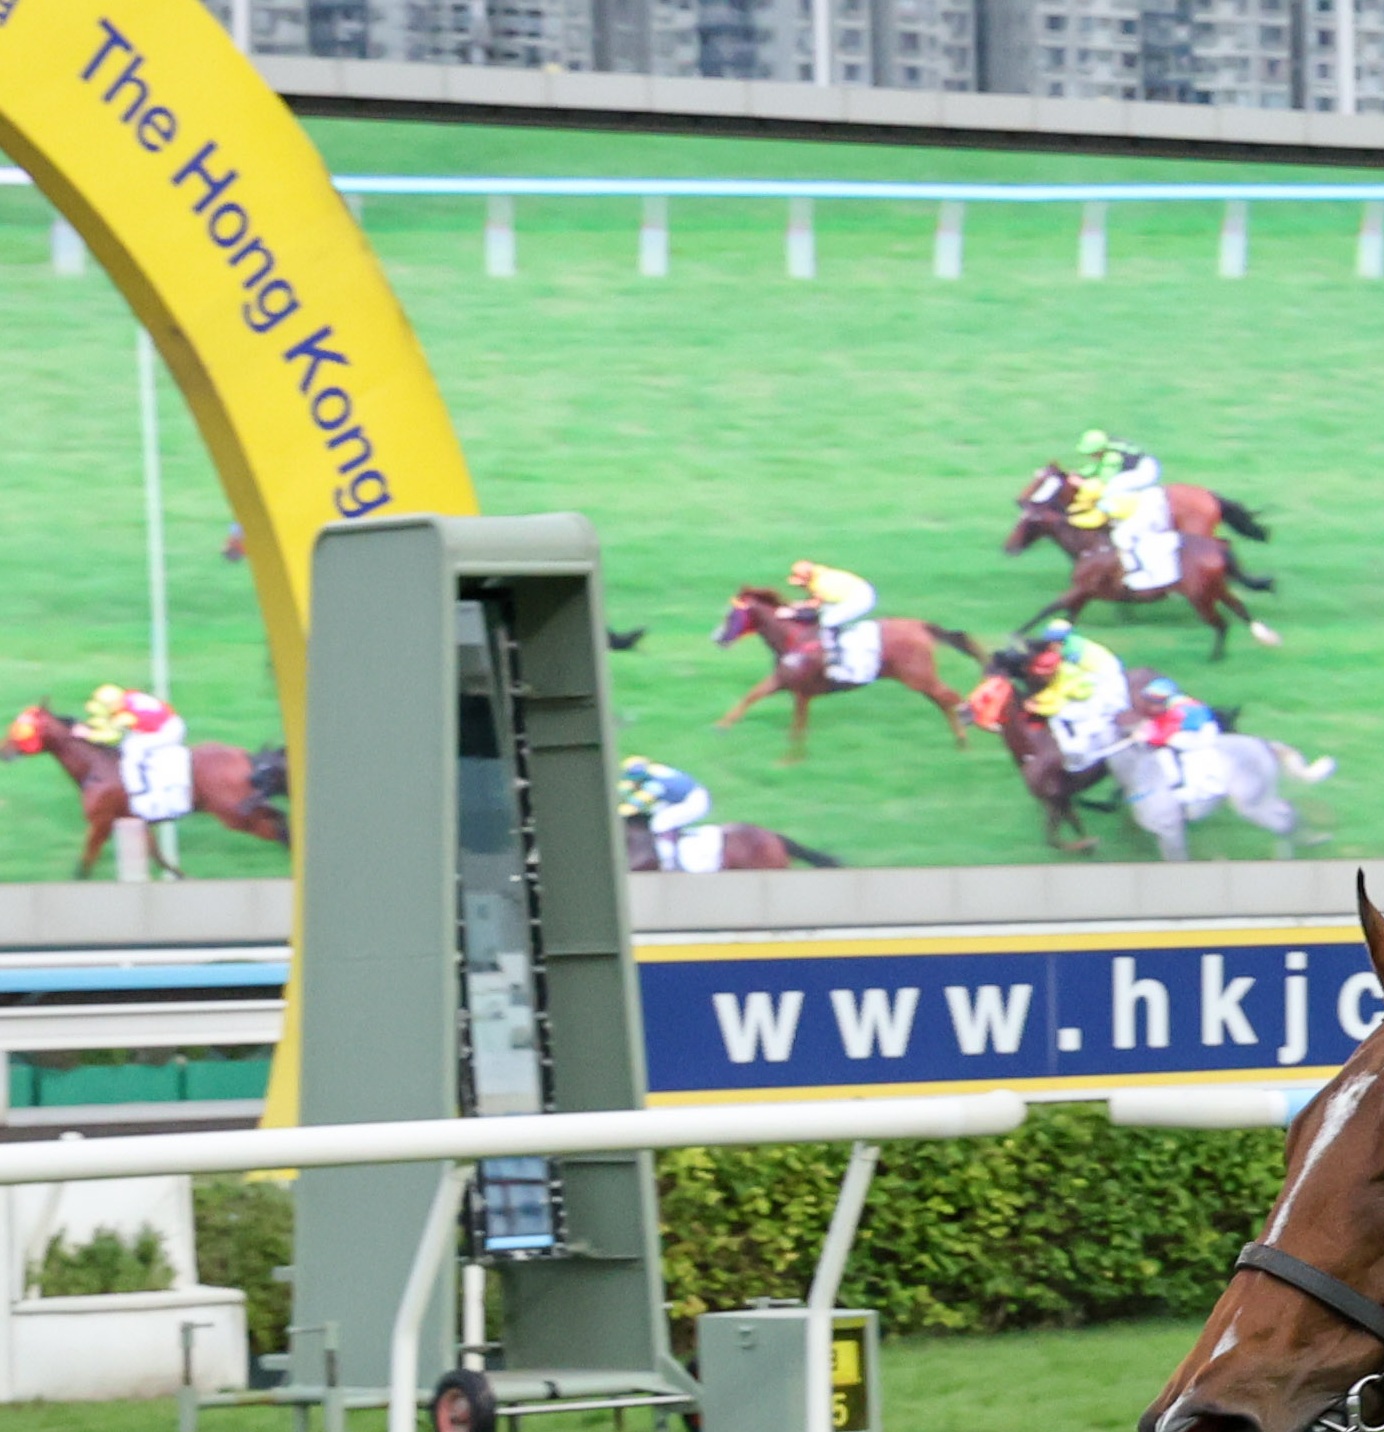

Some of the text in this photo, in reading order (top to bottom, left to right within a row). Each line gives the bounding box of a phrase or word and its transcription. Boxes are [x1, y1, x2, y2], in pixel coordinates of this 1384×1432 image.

[79, 18, 393, 517] The Hong Kong
